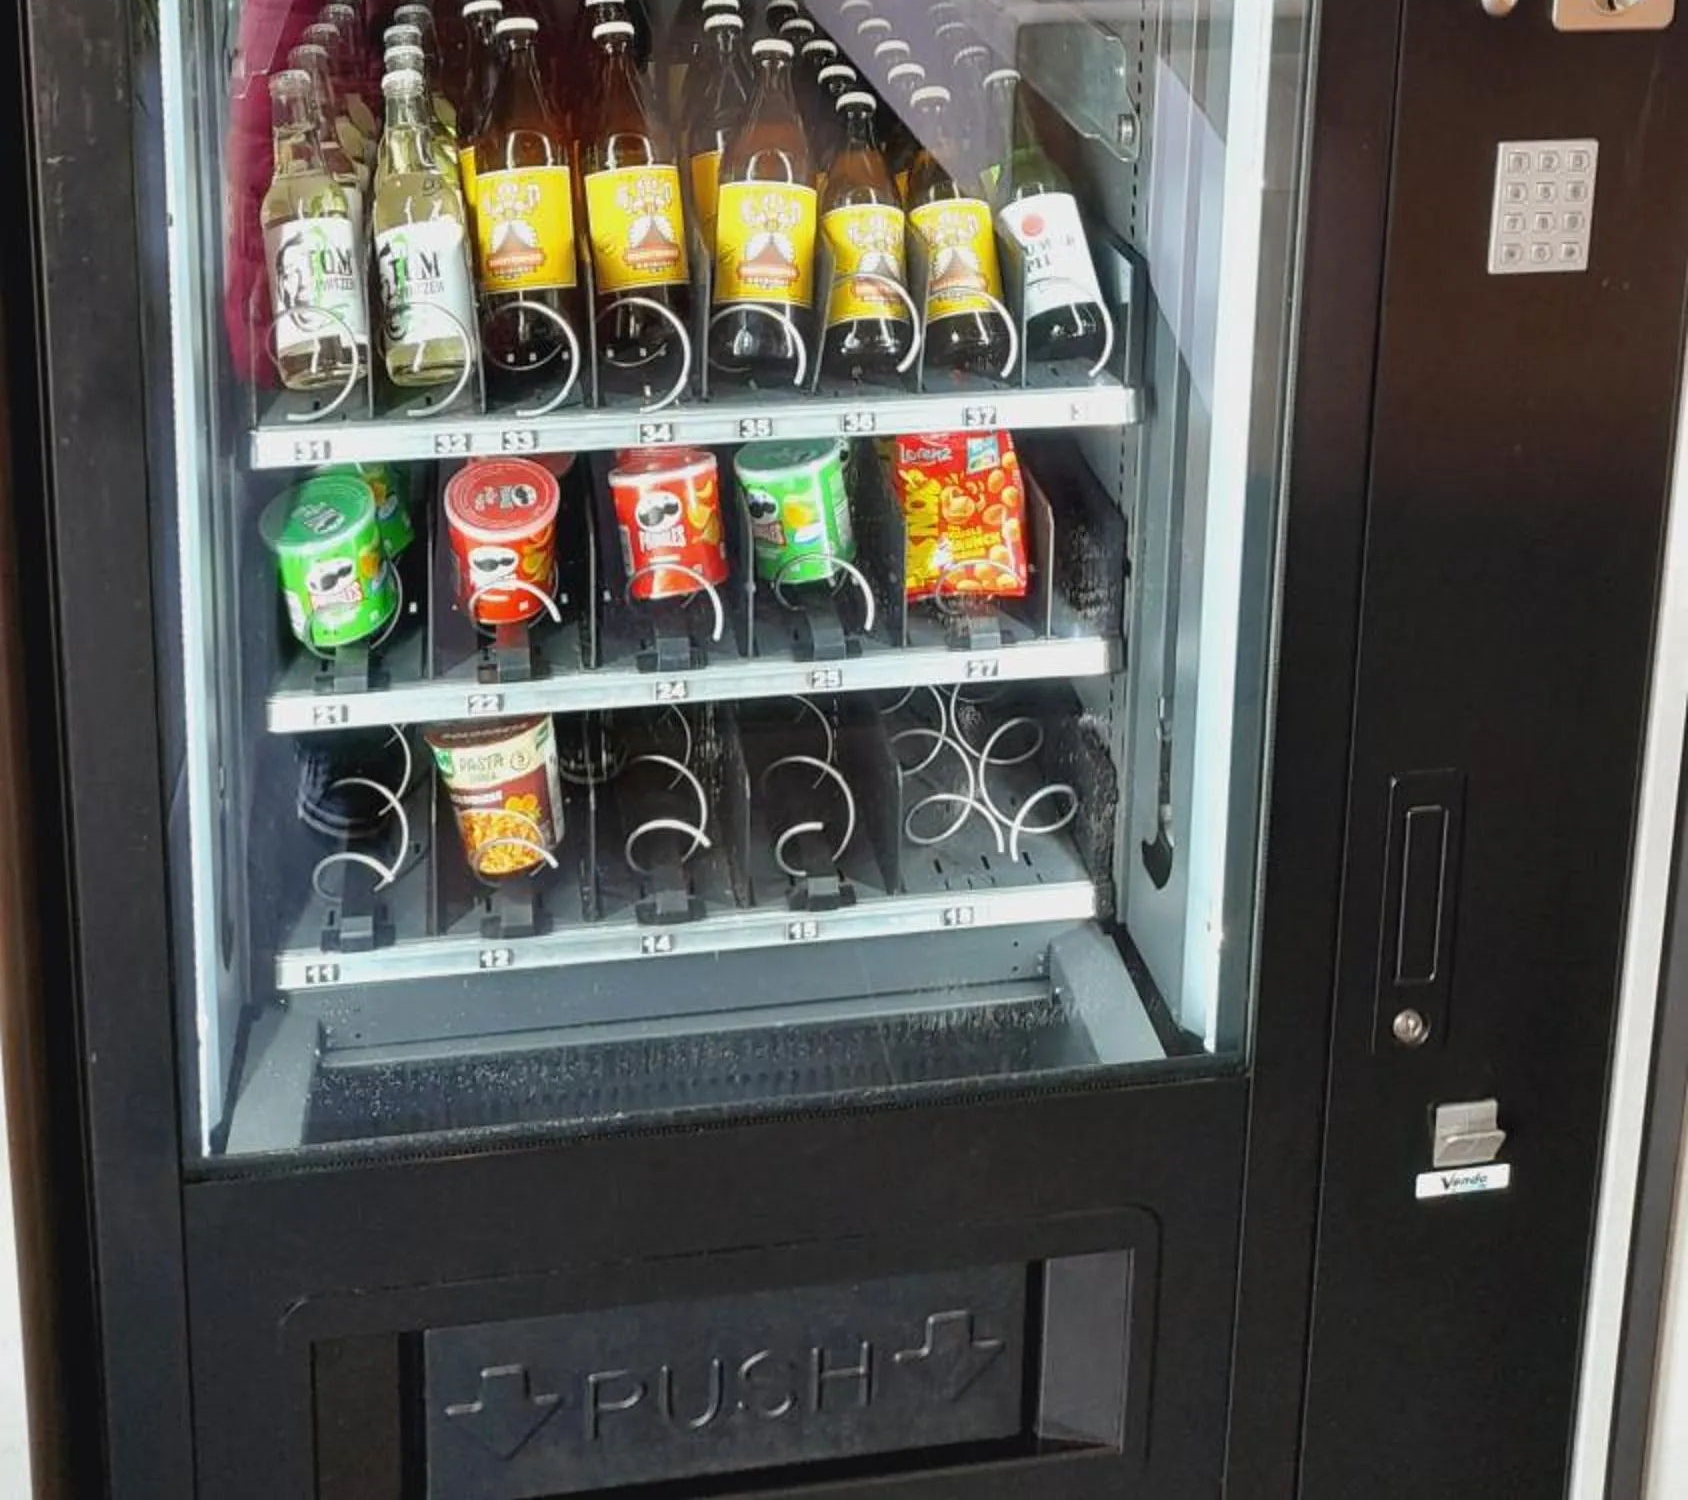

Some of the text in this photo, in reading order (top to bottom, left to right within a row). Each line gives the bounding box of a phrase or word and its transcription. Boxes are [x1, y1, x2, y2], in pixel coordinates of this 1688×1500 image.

[966, 407, 996, 427] 37
[641, 424, 672, 444] 34
[741, 419, 772, 438] 35
[437, 434, 469, 453] 32
[503, 431, 535, 451] 33
[968, 659, 998, 678] 27
[811, 669, 842, 689] 25
[656, 681, 687, 701] 24
[469, 694, 501, 714] 22
[643, 934, 672, 954] 14
[306, 964, 335, 984] 11
[584, 1338, 875, 1441] PUSH
